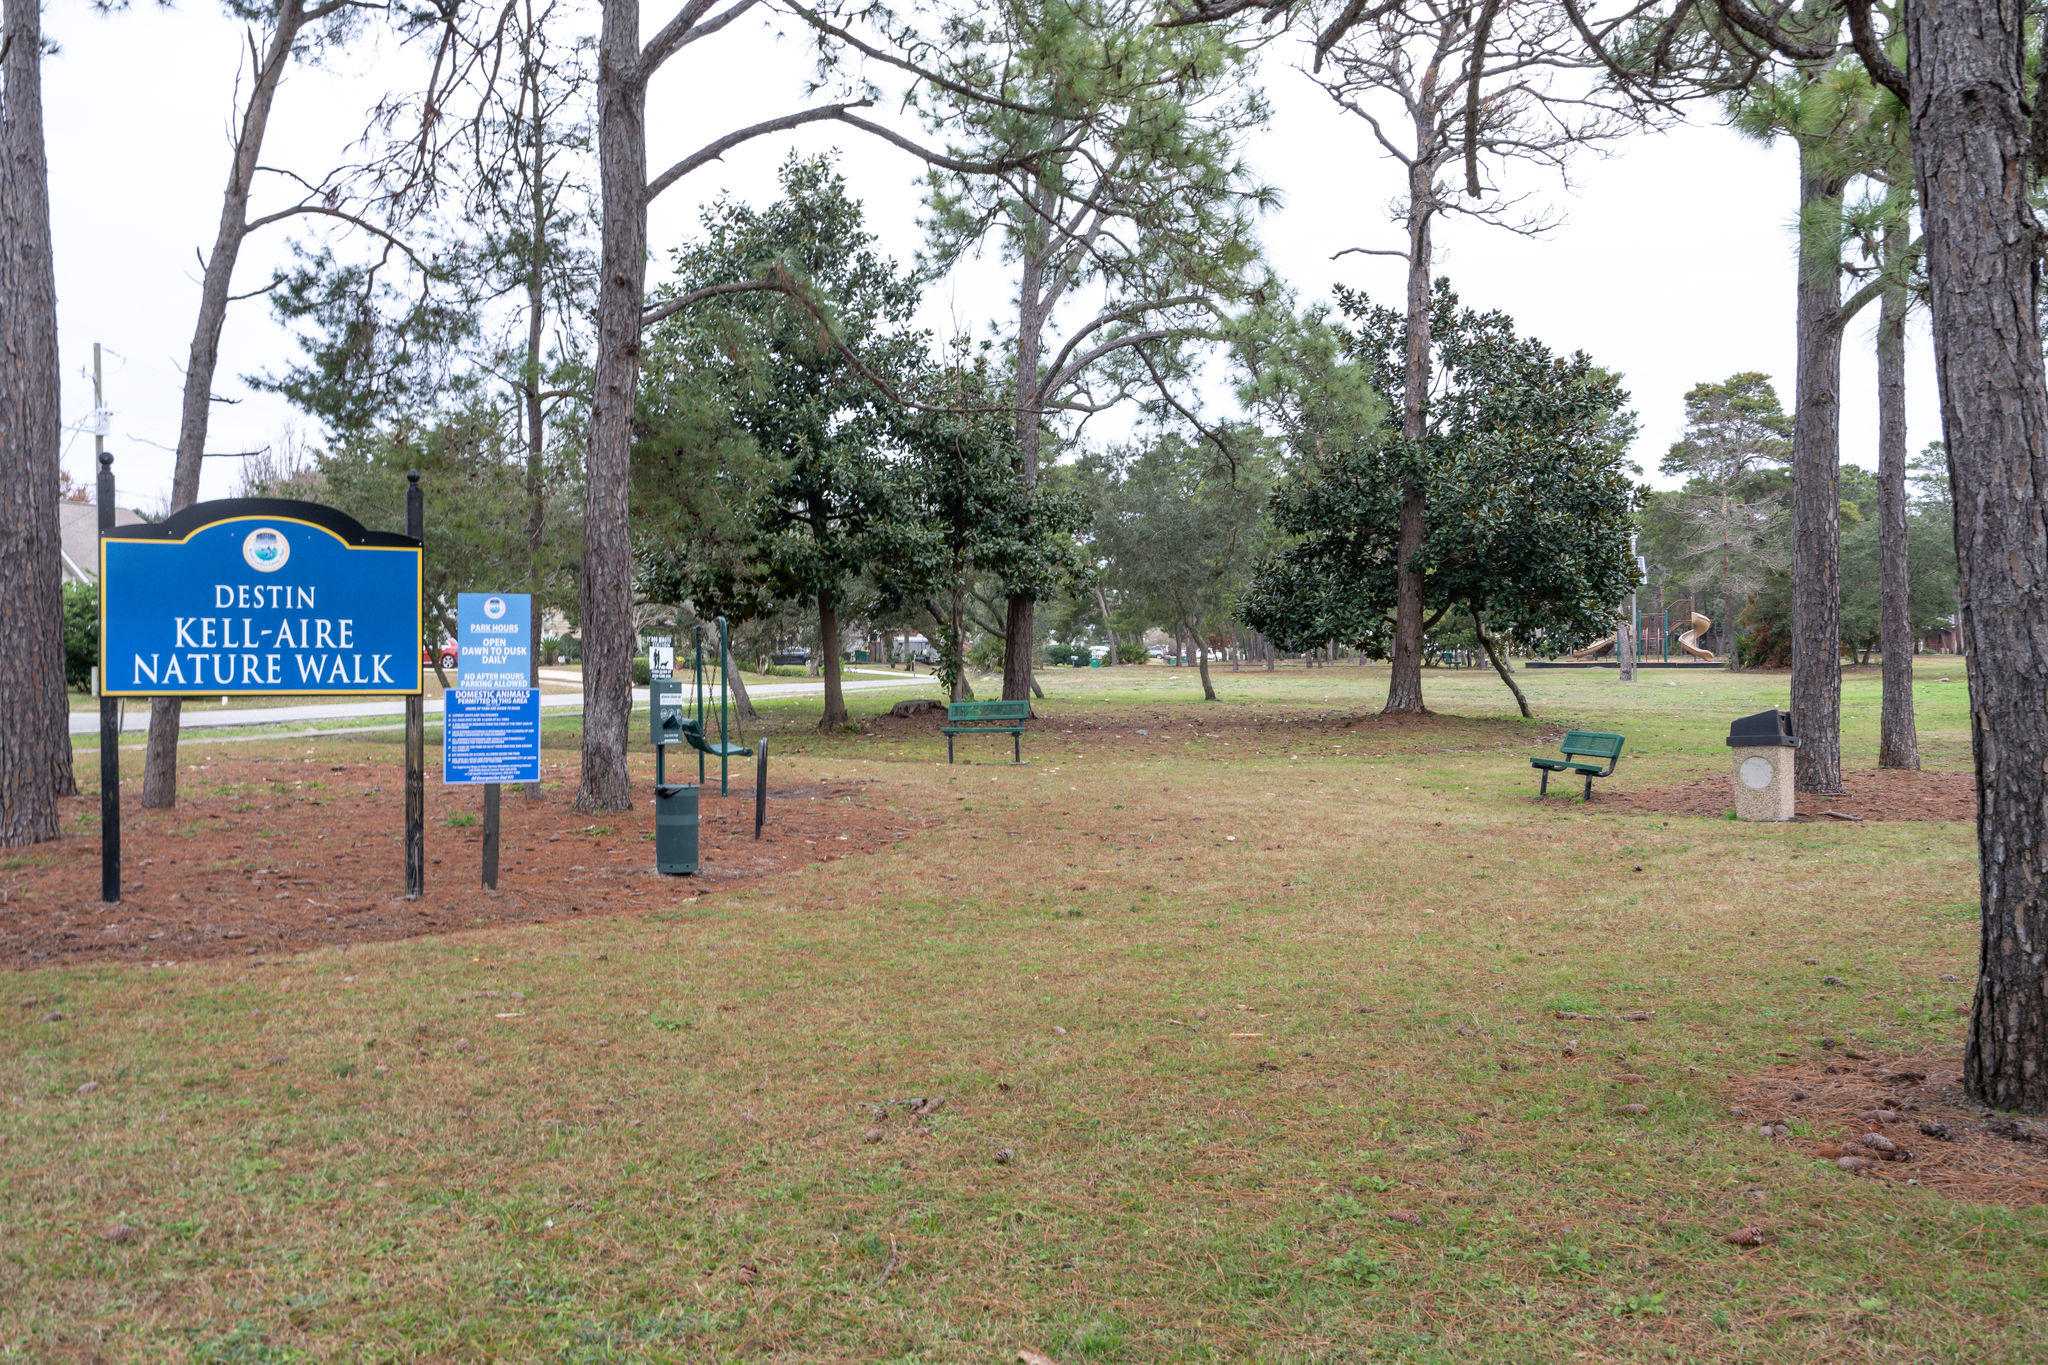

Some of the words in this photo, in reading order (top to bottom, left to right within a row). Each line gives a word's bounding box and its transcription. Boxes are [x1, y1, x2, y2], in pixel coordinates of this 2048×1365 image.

[214, 584, 315, 610] DESTIN
[174, 617, 354, 649] KELL-AIRE
[470, 624, 491, 633] PARK
[492, 624, 519, 633] HOURS
[483, 638, 506, 647] OPEN
[461, 647, 489, 655] DAWN
[490, 647, 502, 655] TO
[504, 647, 527, 655] DUSK
[482, 656, 507, 664] DAILY
[133, 653, 282, 685] NATURE
[295, 654, 394, 684] WALK
[460, 680, 493, 688] PARKING
[493, 680, 528, 688] ALLOWED
[455, 690, 495, 699] DOMESTIC
[496, 690, 531, 698] ANIMALS
